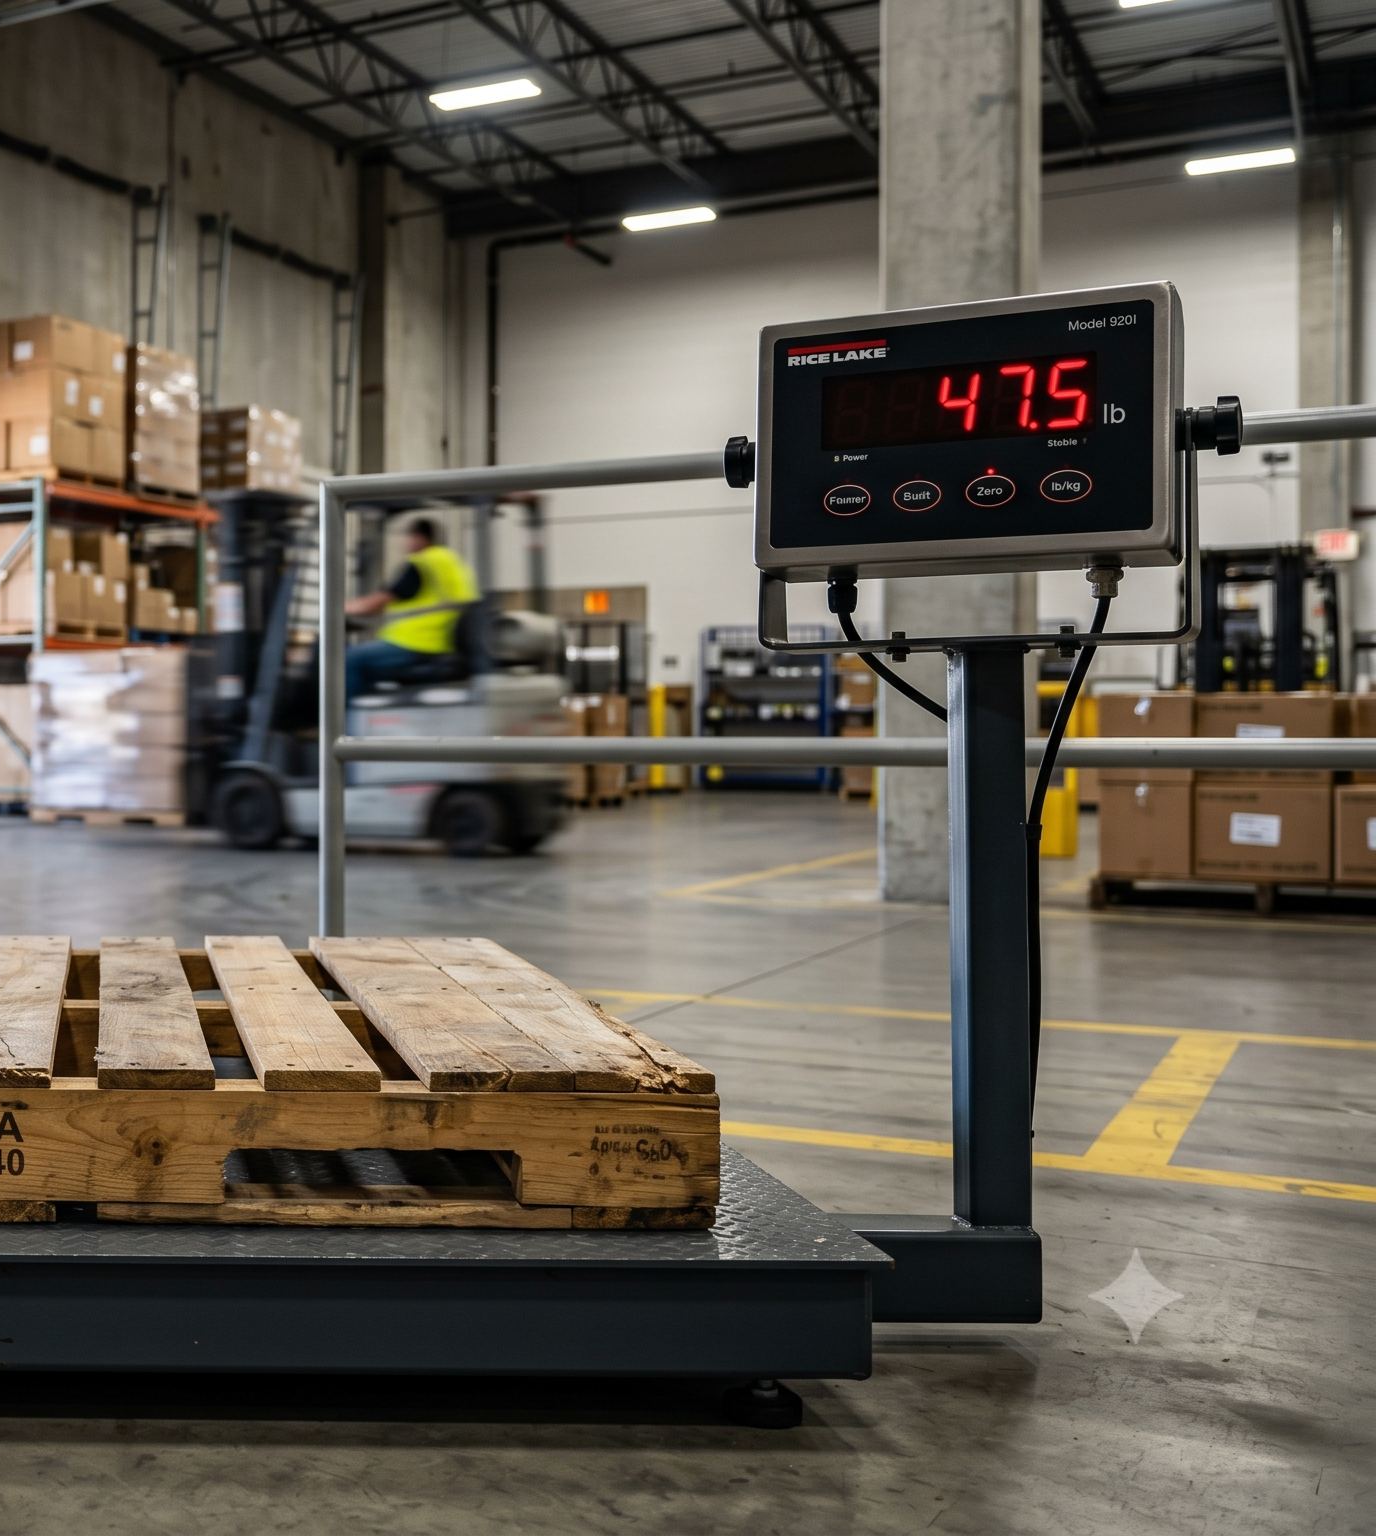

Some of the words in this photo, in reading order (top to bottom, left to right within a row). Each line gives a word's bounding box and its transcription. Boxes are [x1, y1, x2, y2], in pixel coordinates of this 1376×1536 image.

[1068, 317, 1106, 331] Model
[787, 353, 831, 367] RICE
[832, 347, 887, 362] LAKE
[938, 358, 1088, 431] 47.5
[1103, 403, 1126, 424] lb
[842, 454, 869, 462] Power
[976, 487, 1003, 496] Zero
[1051, 481, 1081, 492] lb/kg
